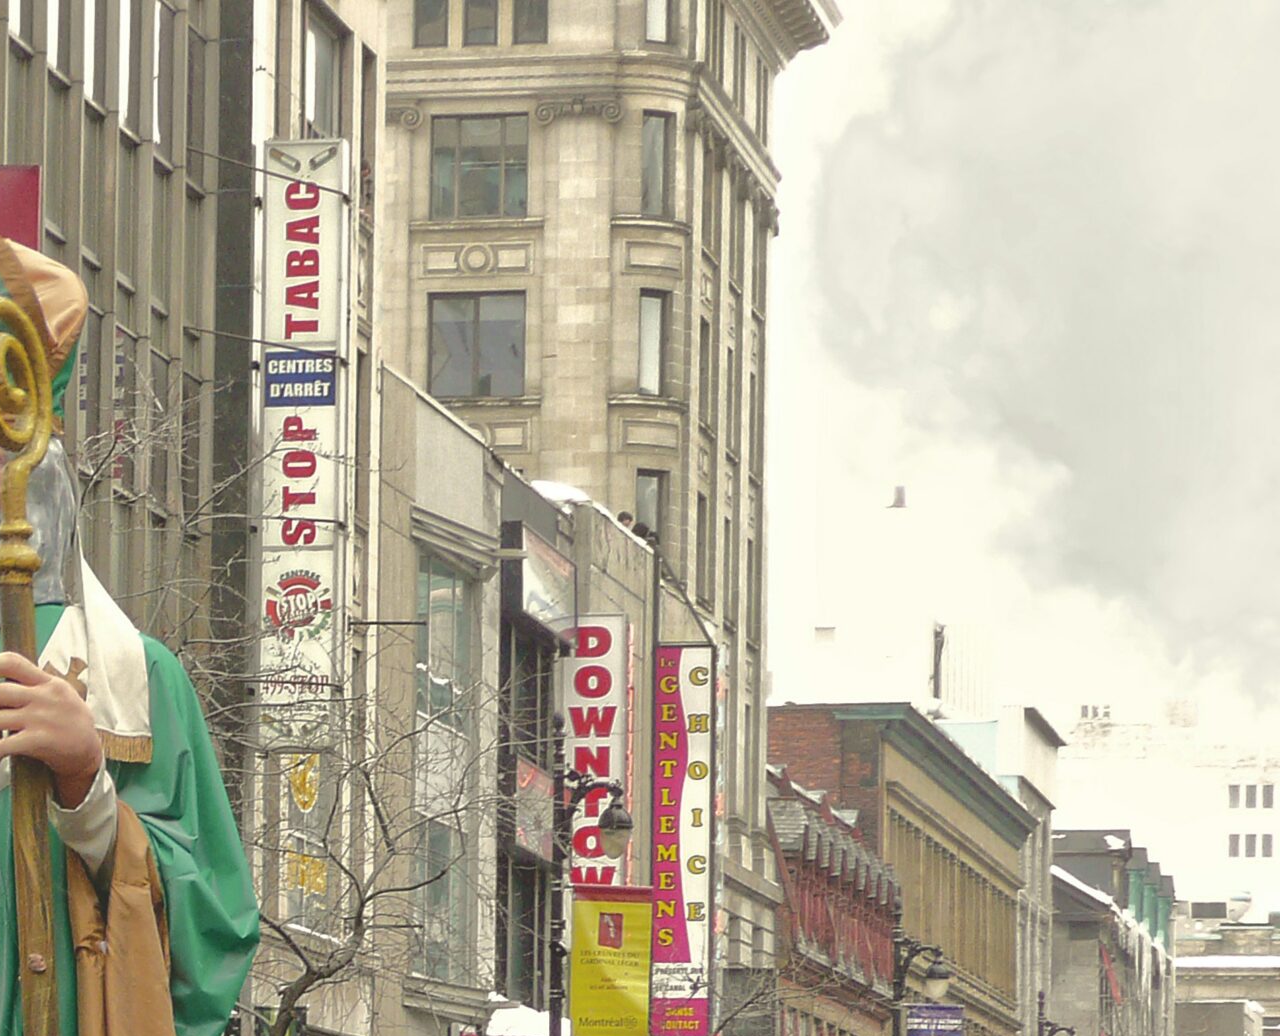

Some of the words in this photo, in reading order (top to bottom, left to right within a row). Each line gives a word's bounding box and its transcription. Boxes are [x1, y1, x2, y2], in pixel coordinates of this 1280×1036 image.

[284, 180, 321, 340] TABAC
[268, 357, 333, 375] CENTRES
[269, 379, 331, 398] D'ARRÊT
[281, 415, 317, 546] STOP
[281, 592, 316, 612] STOP
[686, 666, 710, 922] CHOICE
[578, 1016, 624, 1027] Montréal
